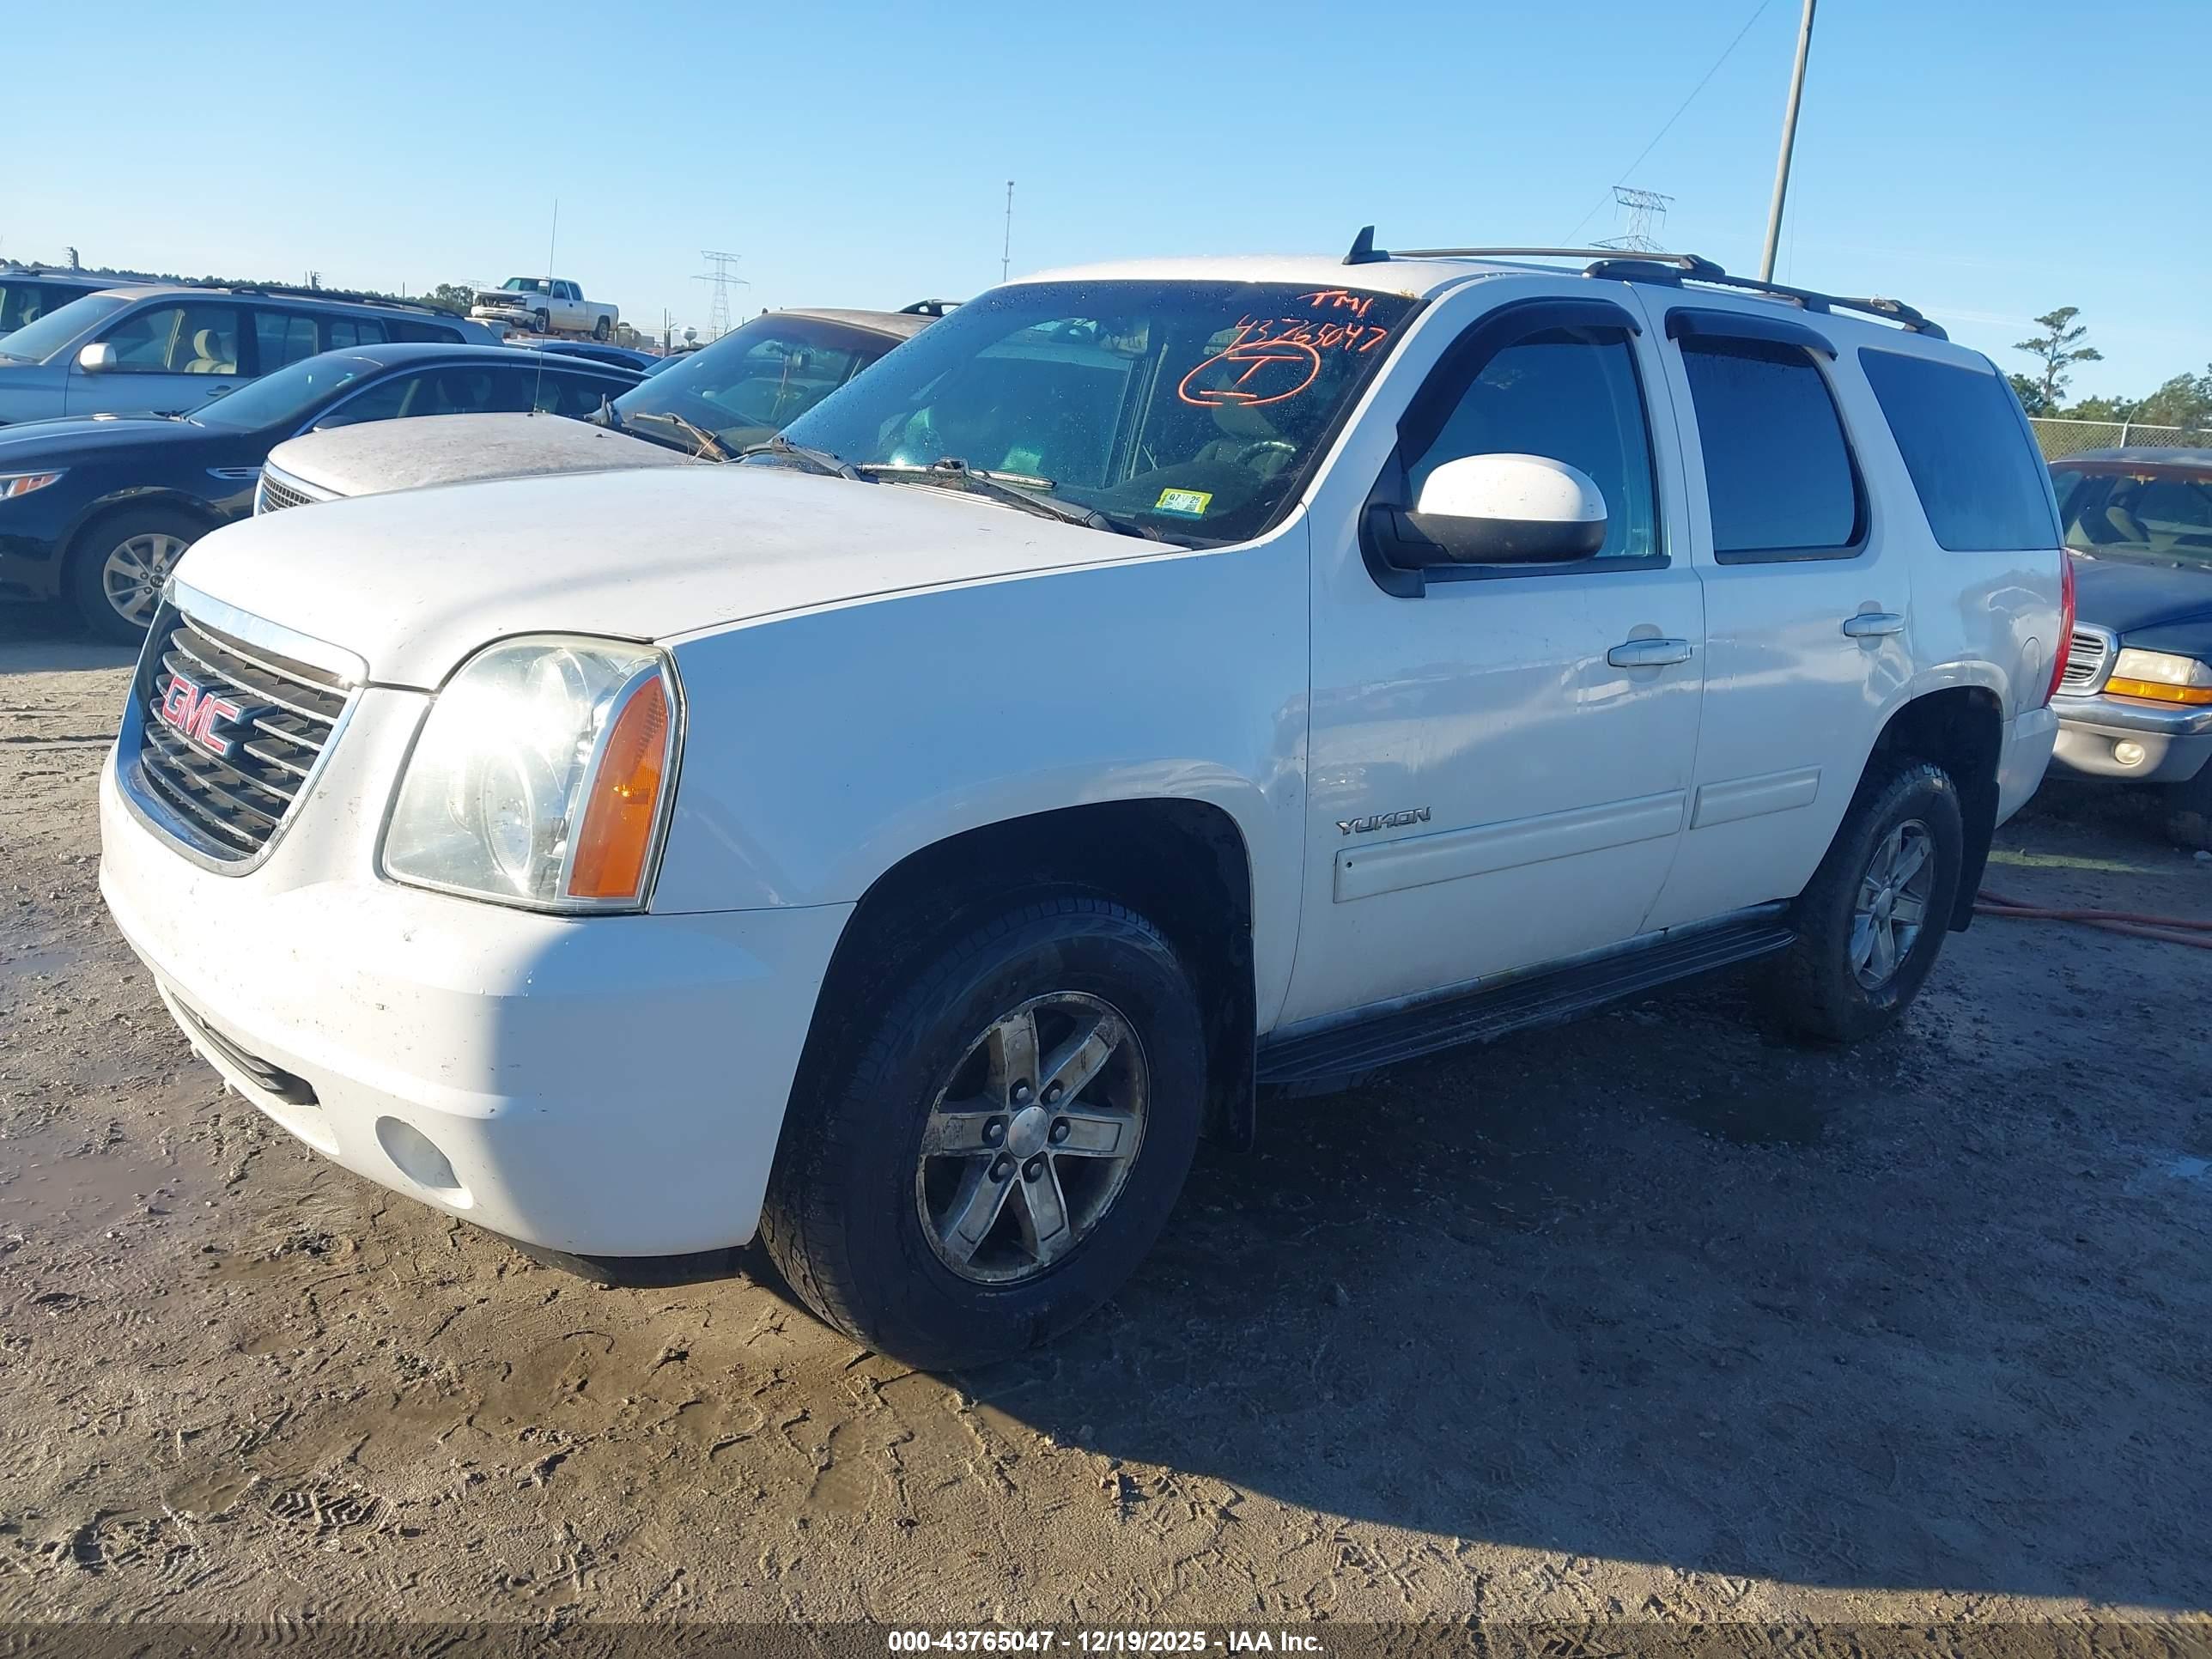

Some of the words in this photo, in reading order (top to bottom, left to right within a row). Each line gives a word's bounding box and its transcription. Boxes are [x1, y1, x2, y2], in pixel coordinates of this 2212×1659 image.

[1224, 313, 1388, 354] 43765047
[161, 674, 242, 757] GMC
[1335, 806, 1432, 836] YUKON
